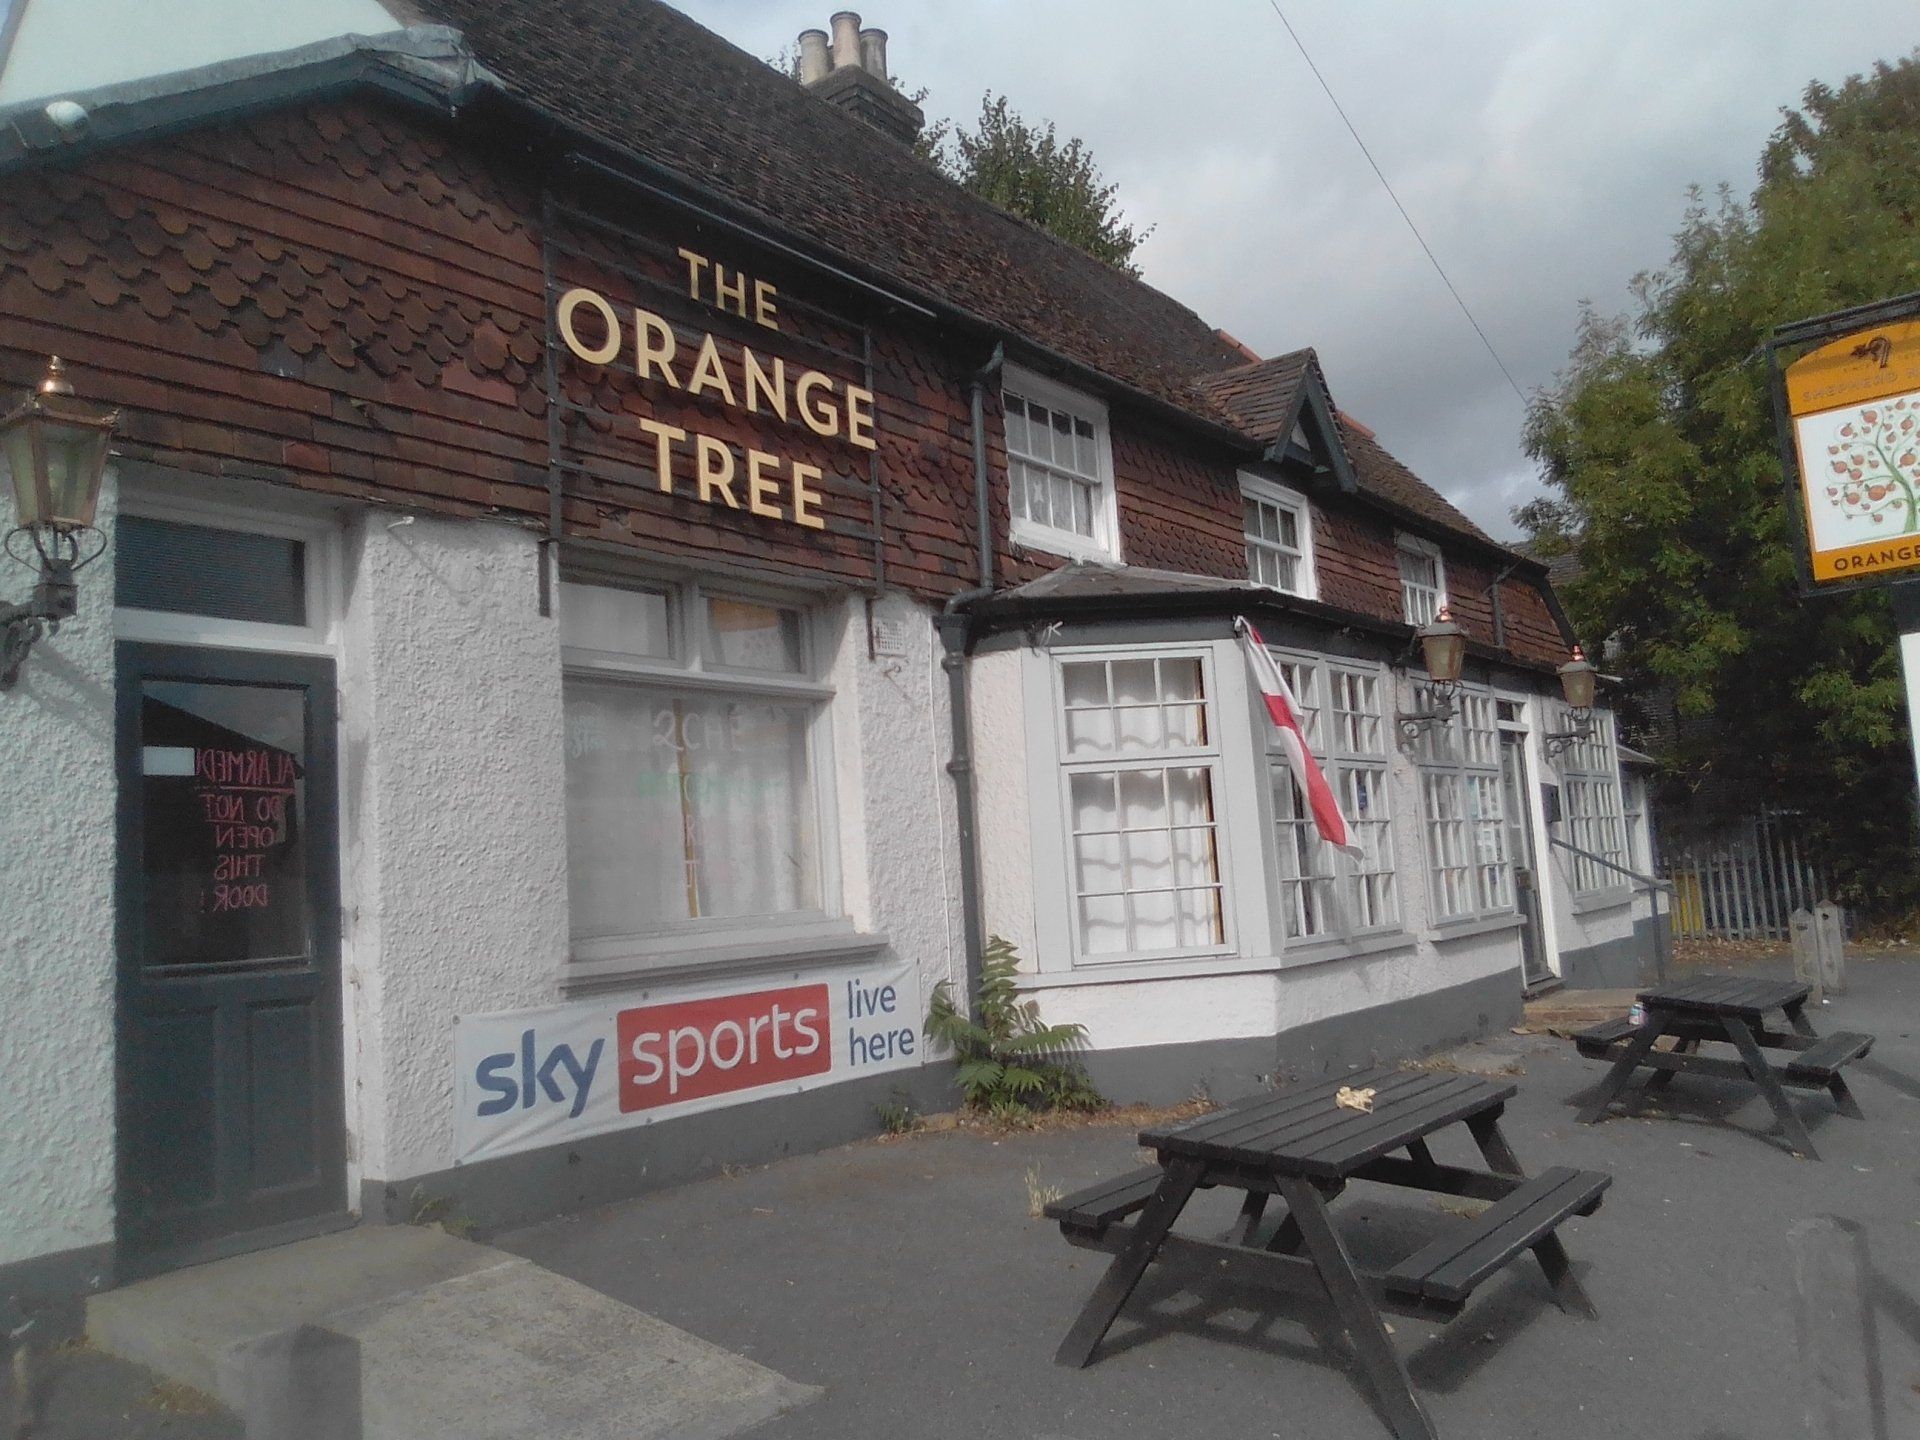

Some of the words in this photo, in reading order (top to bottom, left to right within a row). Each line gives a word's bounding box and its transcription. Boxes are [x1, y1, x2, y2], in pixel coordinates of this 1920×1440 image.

[678, 247, 779, 331] THE
[557, 288, 876, 450] ORANGE
[639, 417, 825, 529] TREE
[1833, 544, 1920, 571] ORANGE
[847, 979, 897, 1019] live
[477, 1028, 605, 1119] sky
[632, 1004, 820, 1094] sports
[849, 1025, 915, 1066] here
